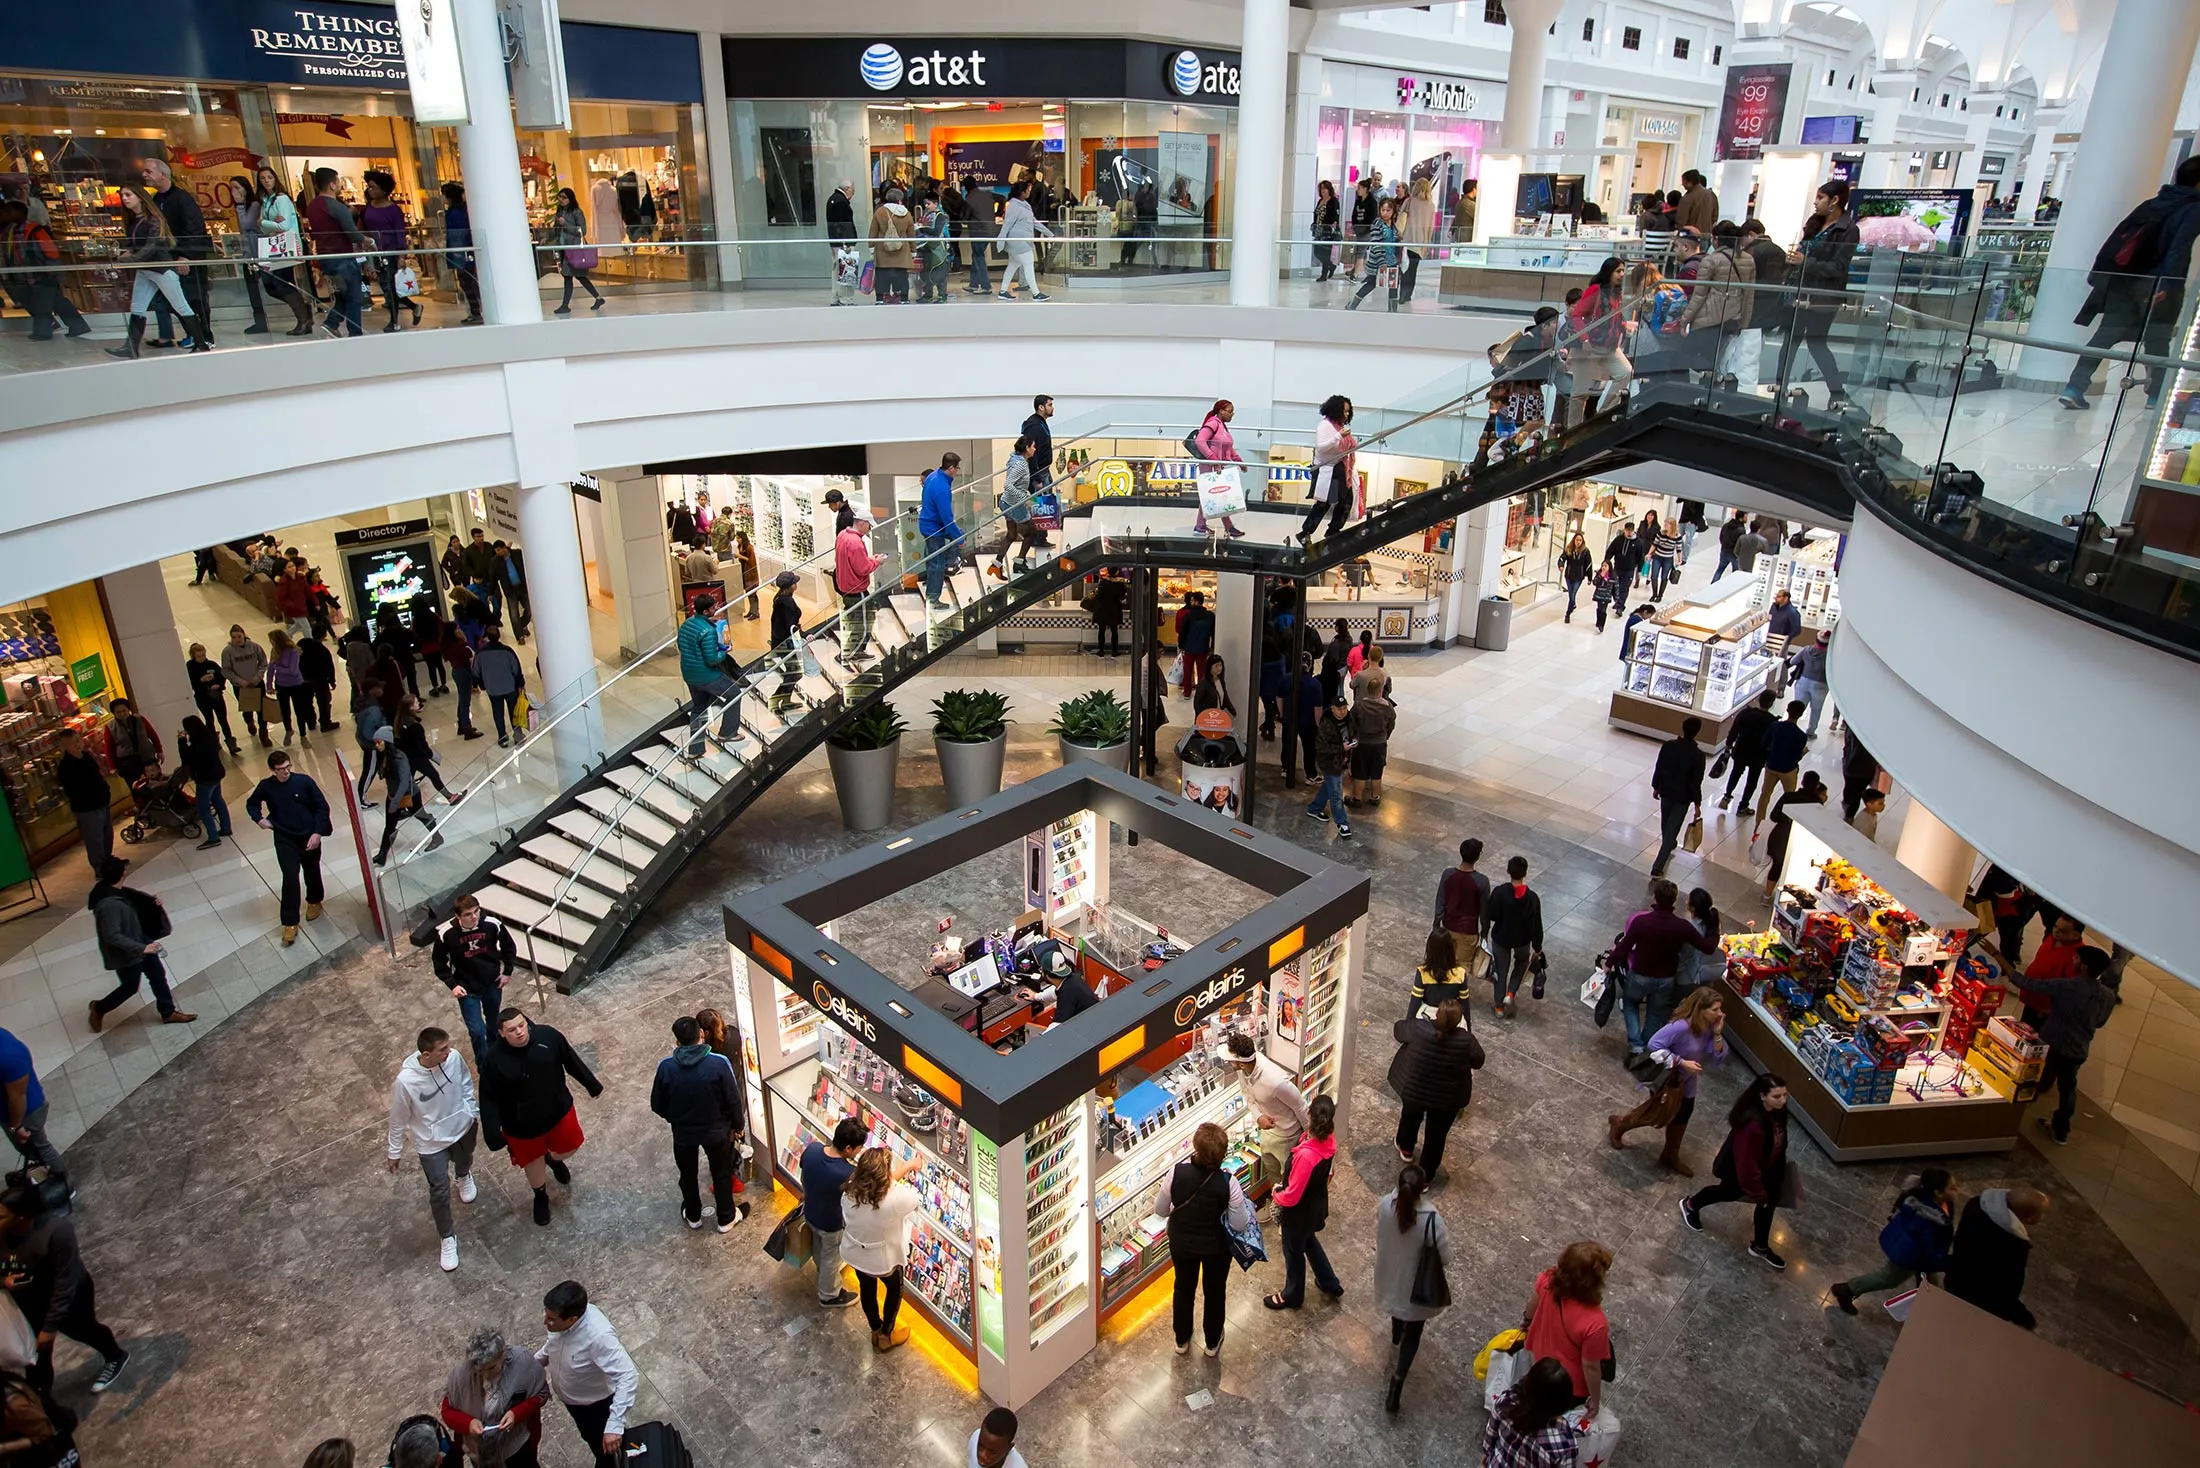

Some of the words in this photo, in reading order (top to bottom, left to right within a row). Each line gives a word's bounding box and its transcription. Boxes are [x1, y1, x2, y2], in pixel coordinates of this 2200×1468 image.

[250, 28, 405, 56] REMEMBE
[303, 64, 384, 78] PERSONALIZED
[907, 50, 986, 86] at&t
[197, 158, 214, 169] BEST
[215, 153, 232, 164] GIFT
[948, 160, 957, 170] It's
[958, 161, 973, 171] your
[974, 159, 985, 169] TV.
[587, 474, 600, 491] hut
[359, 525, 407, 539] Directory
[468, 939, 480, 951] K
[977, 1143, 991, 1195] DEVICE
